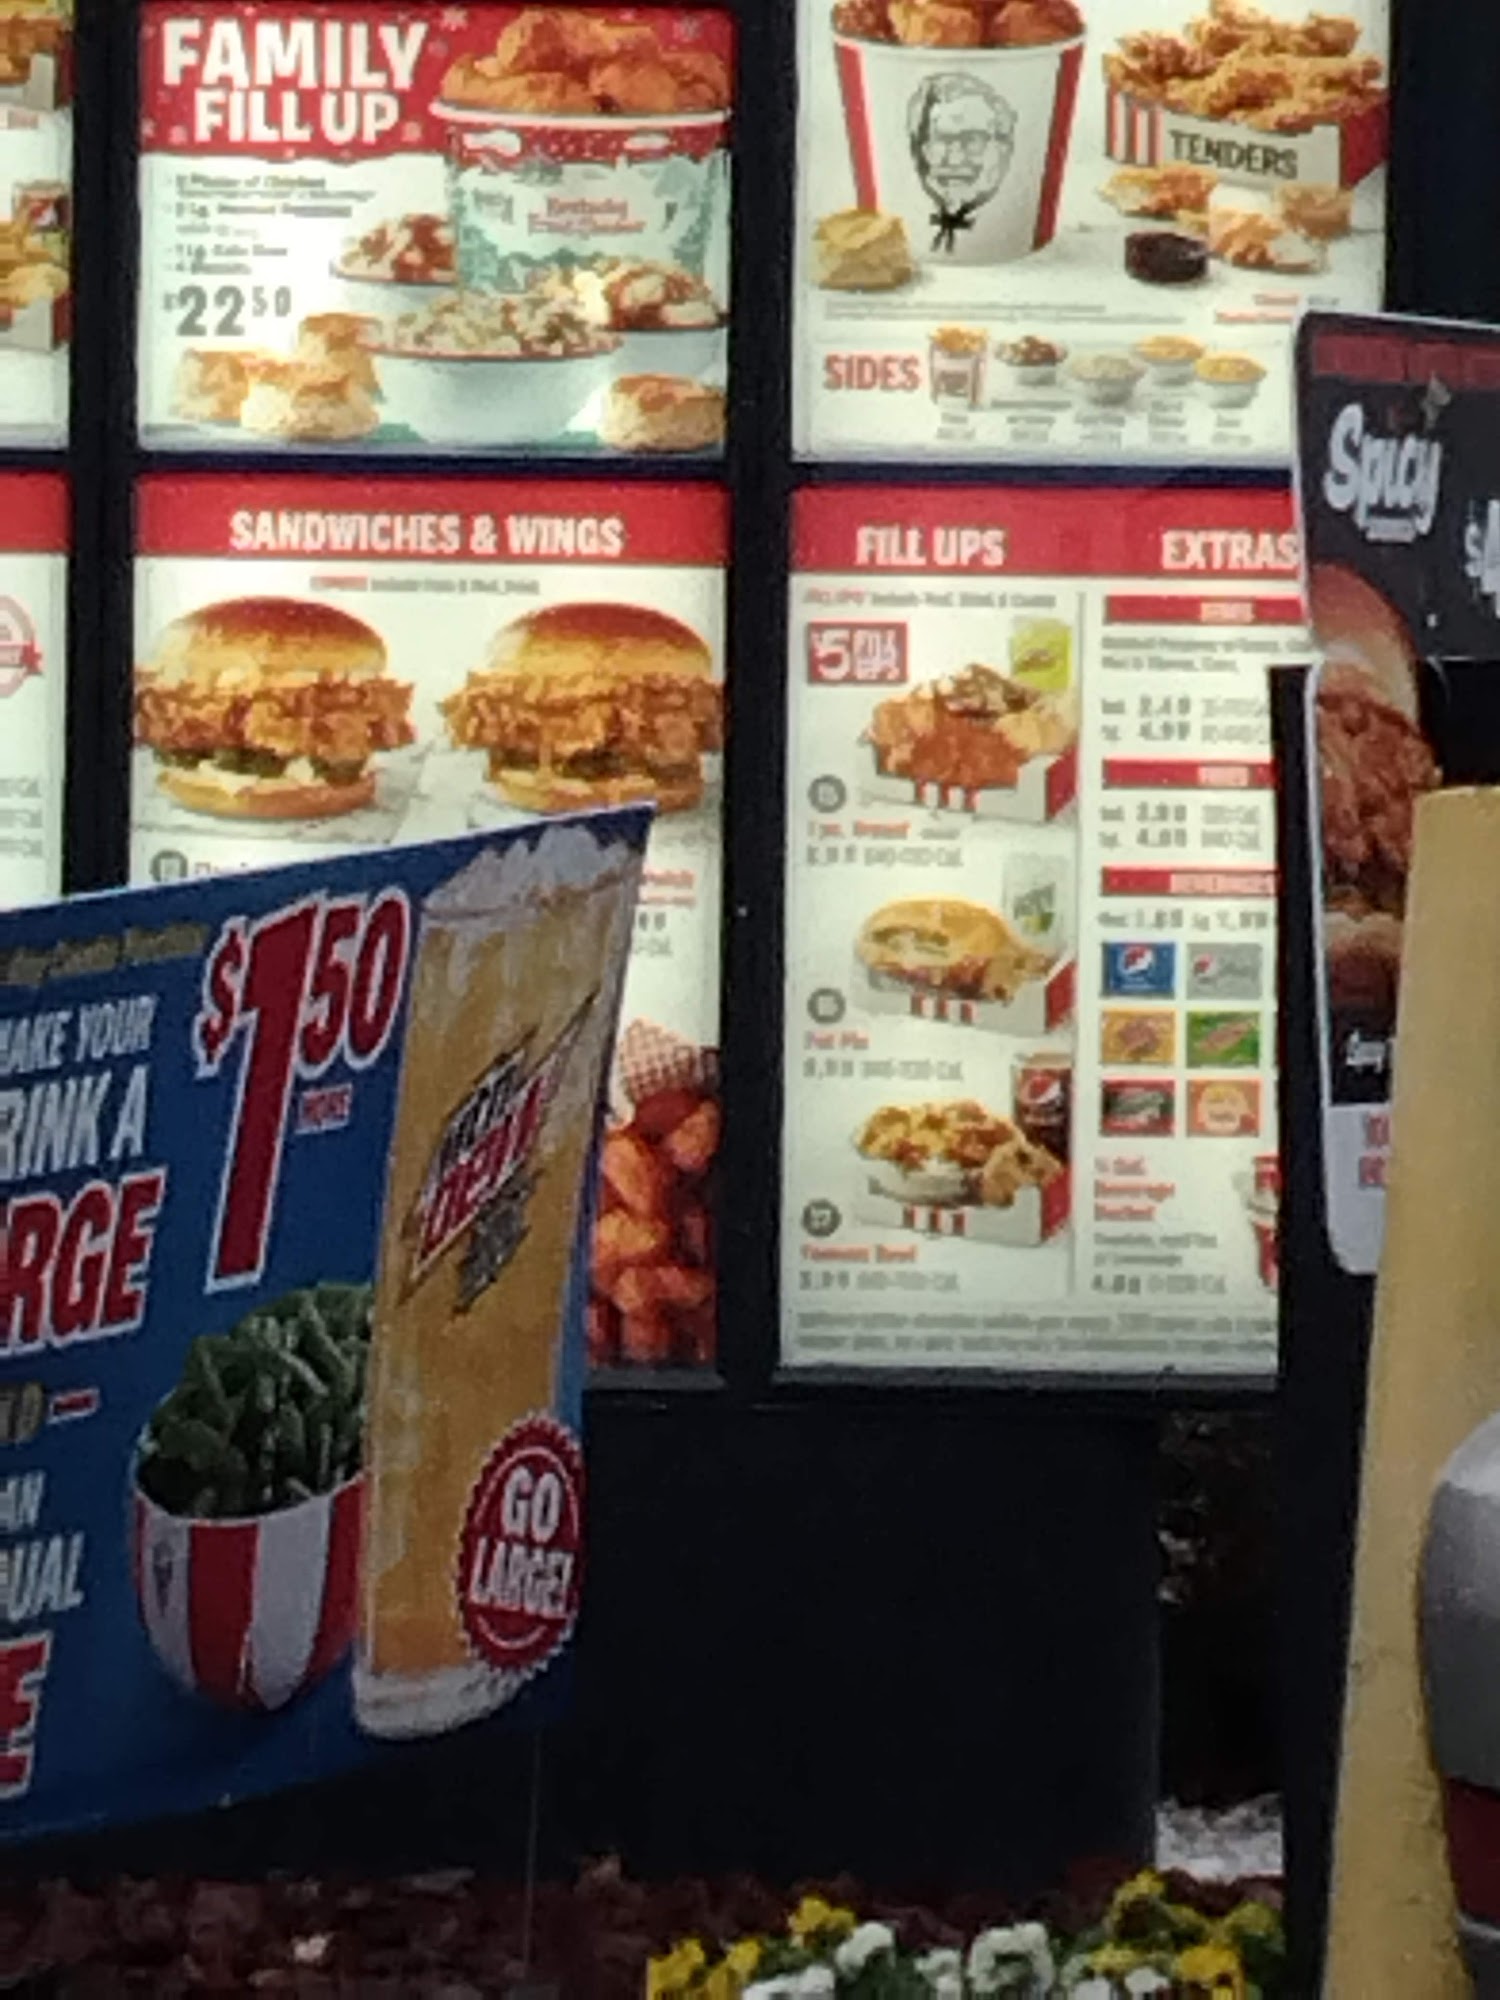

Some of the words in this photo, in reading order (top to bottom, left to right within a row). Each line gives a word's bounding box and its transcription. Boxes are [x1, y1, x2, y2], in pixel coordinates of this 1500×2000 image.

[161, 18, 428, 90] FAMILY
[194, 90, 311, 142] FILL
[322, 93, 400, 143] UP
[1170, 128, 1298, 176] TENDERS
[823, 352, 920, 393] SIDES
[230, 510, 461, 554] SANDWICHES
[470, 514, 497, 554] &
[507, 514, 624, 556] WINGS
[856, 527, 926, 567] FILL
[933, 528, 1006, 568] UPS
[1162, 530, 1299, 570] EXTRAS
[75, 995, 156, 1062] YOUR
[111, 1065, 148, 1159] A
[0, 1163, 167, 1356] RGE
[504, 1466, 562, 1544] GO
